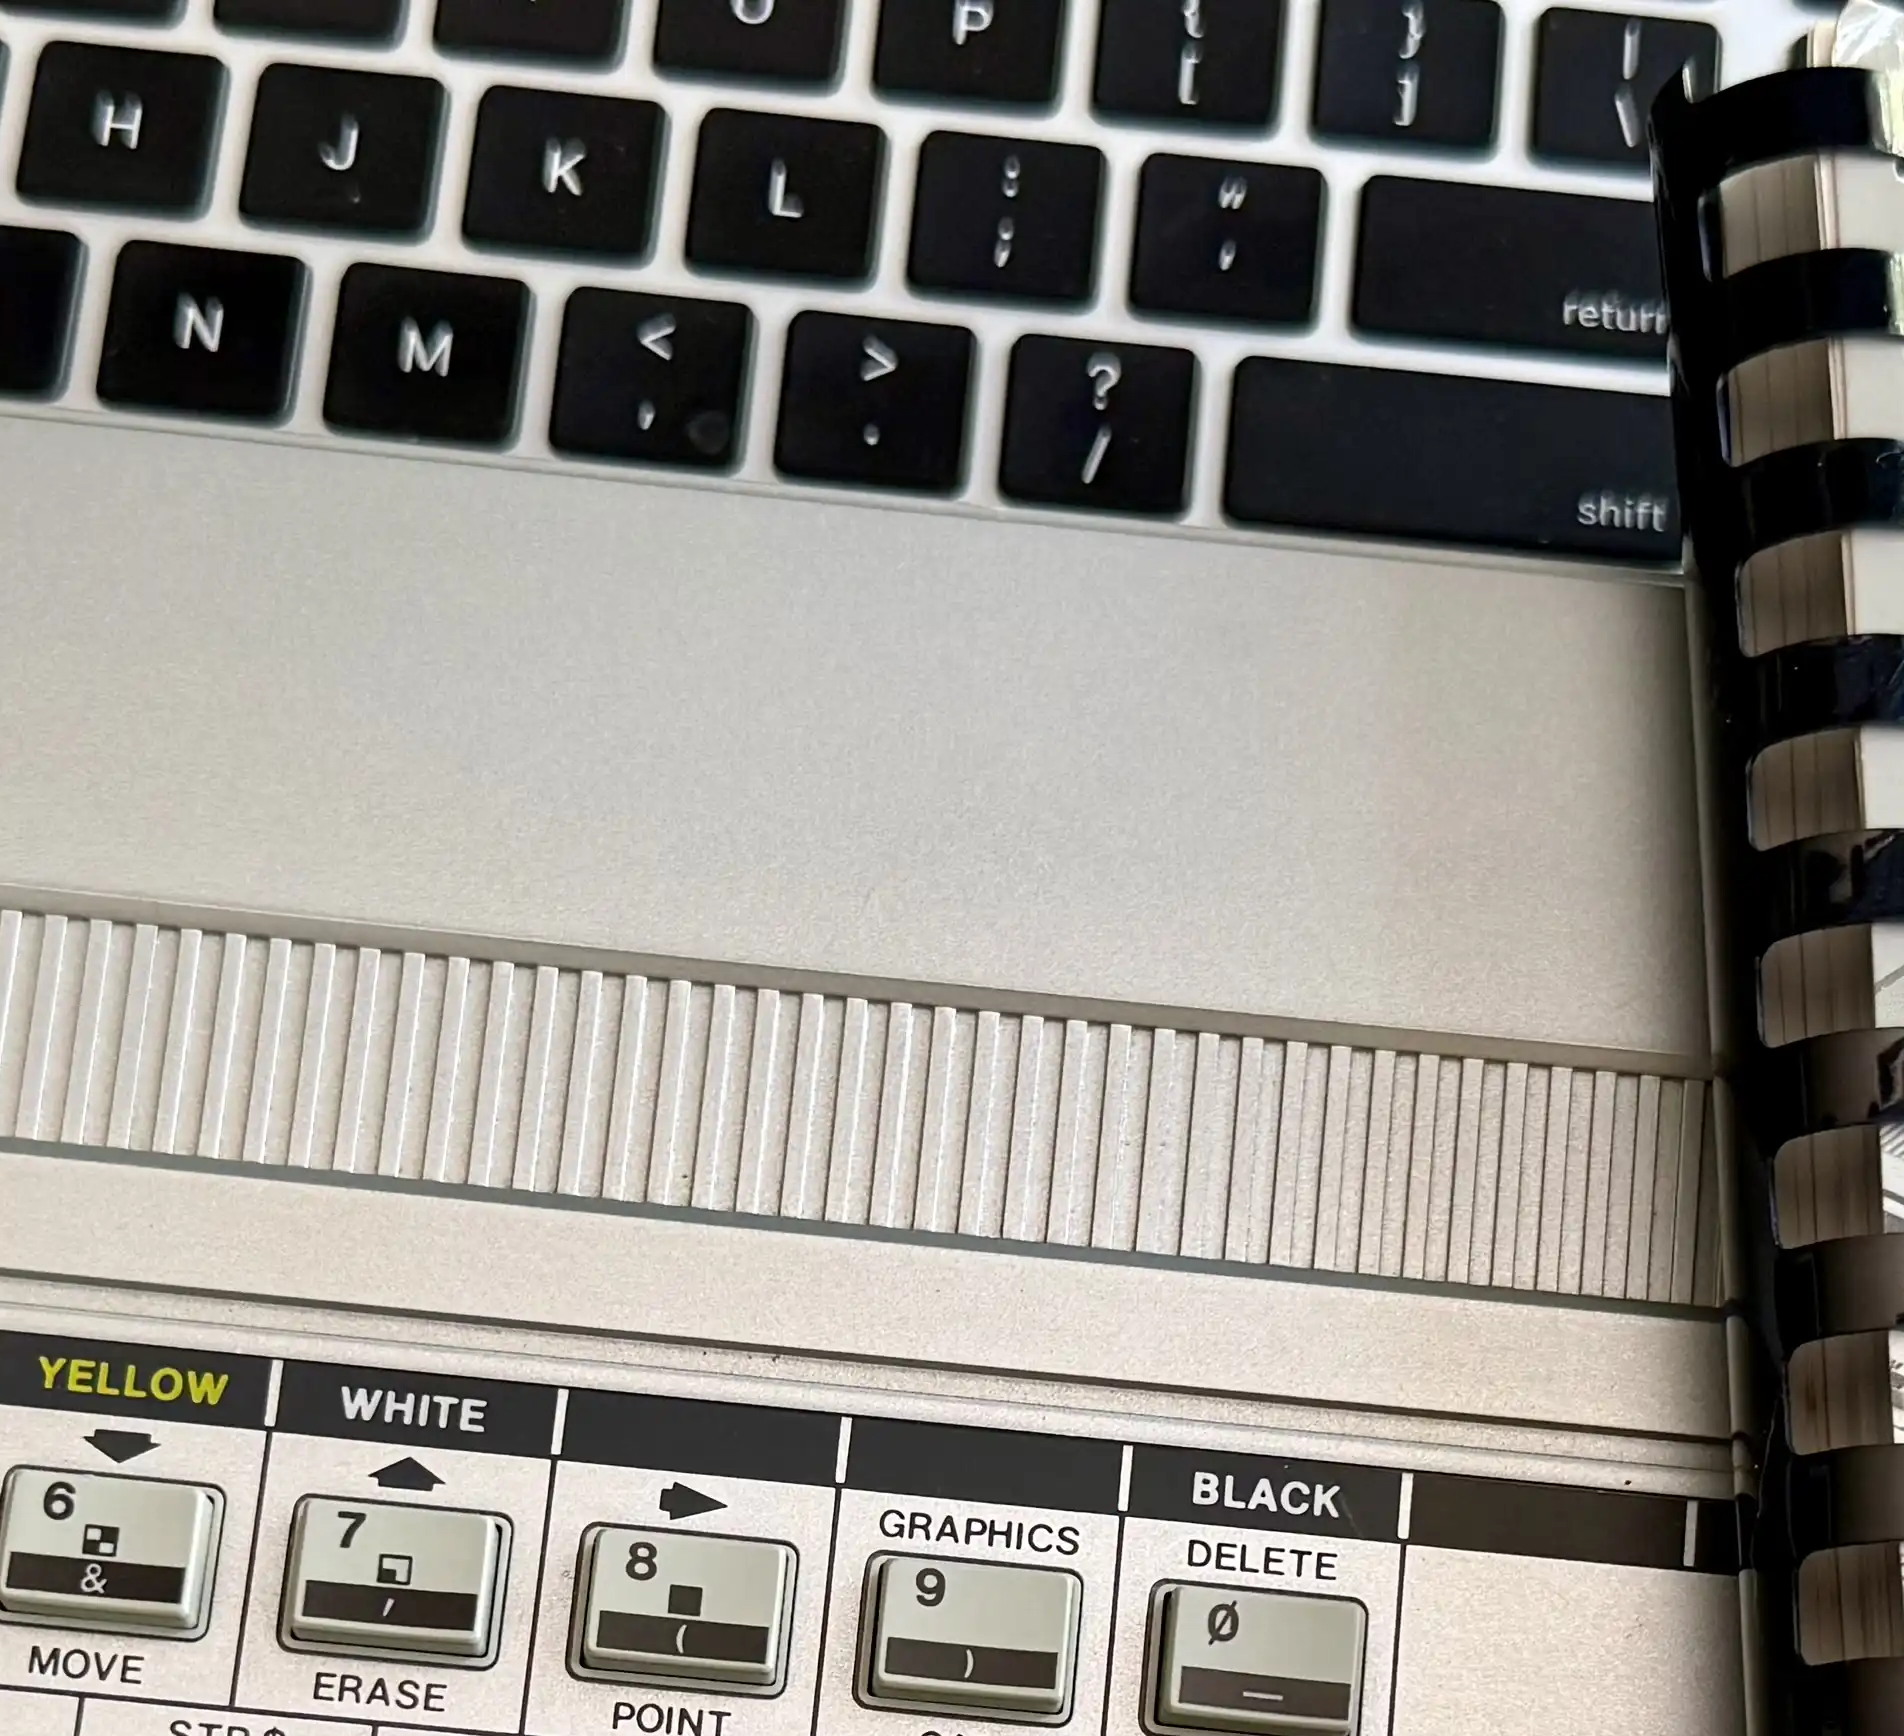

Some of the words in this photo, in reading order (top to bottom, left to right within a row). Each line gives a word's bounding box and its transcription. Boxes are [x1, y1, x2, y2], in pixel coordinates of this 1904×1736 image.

[768, 160, 802, 218] L
[1577, 492, 1669, 532] shift
[39, 1356, 228, 1405] YELLOW
[342, 1387, 487, 1432] WHITE
[1193, 1472, 1340, 1517] BLACK
[880, 1510, 1079, 1555] GRAPHICS
[1188, 1540, 1338, 1580] DELETE
[29, 1646, 144, 1684] MOVE
[313, 1672, 447, 1712] ERASE
